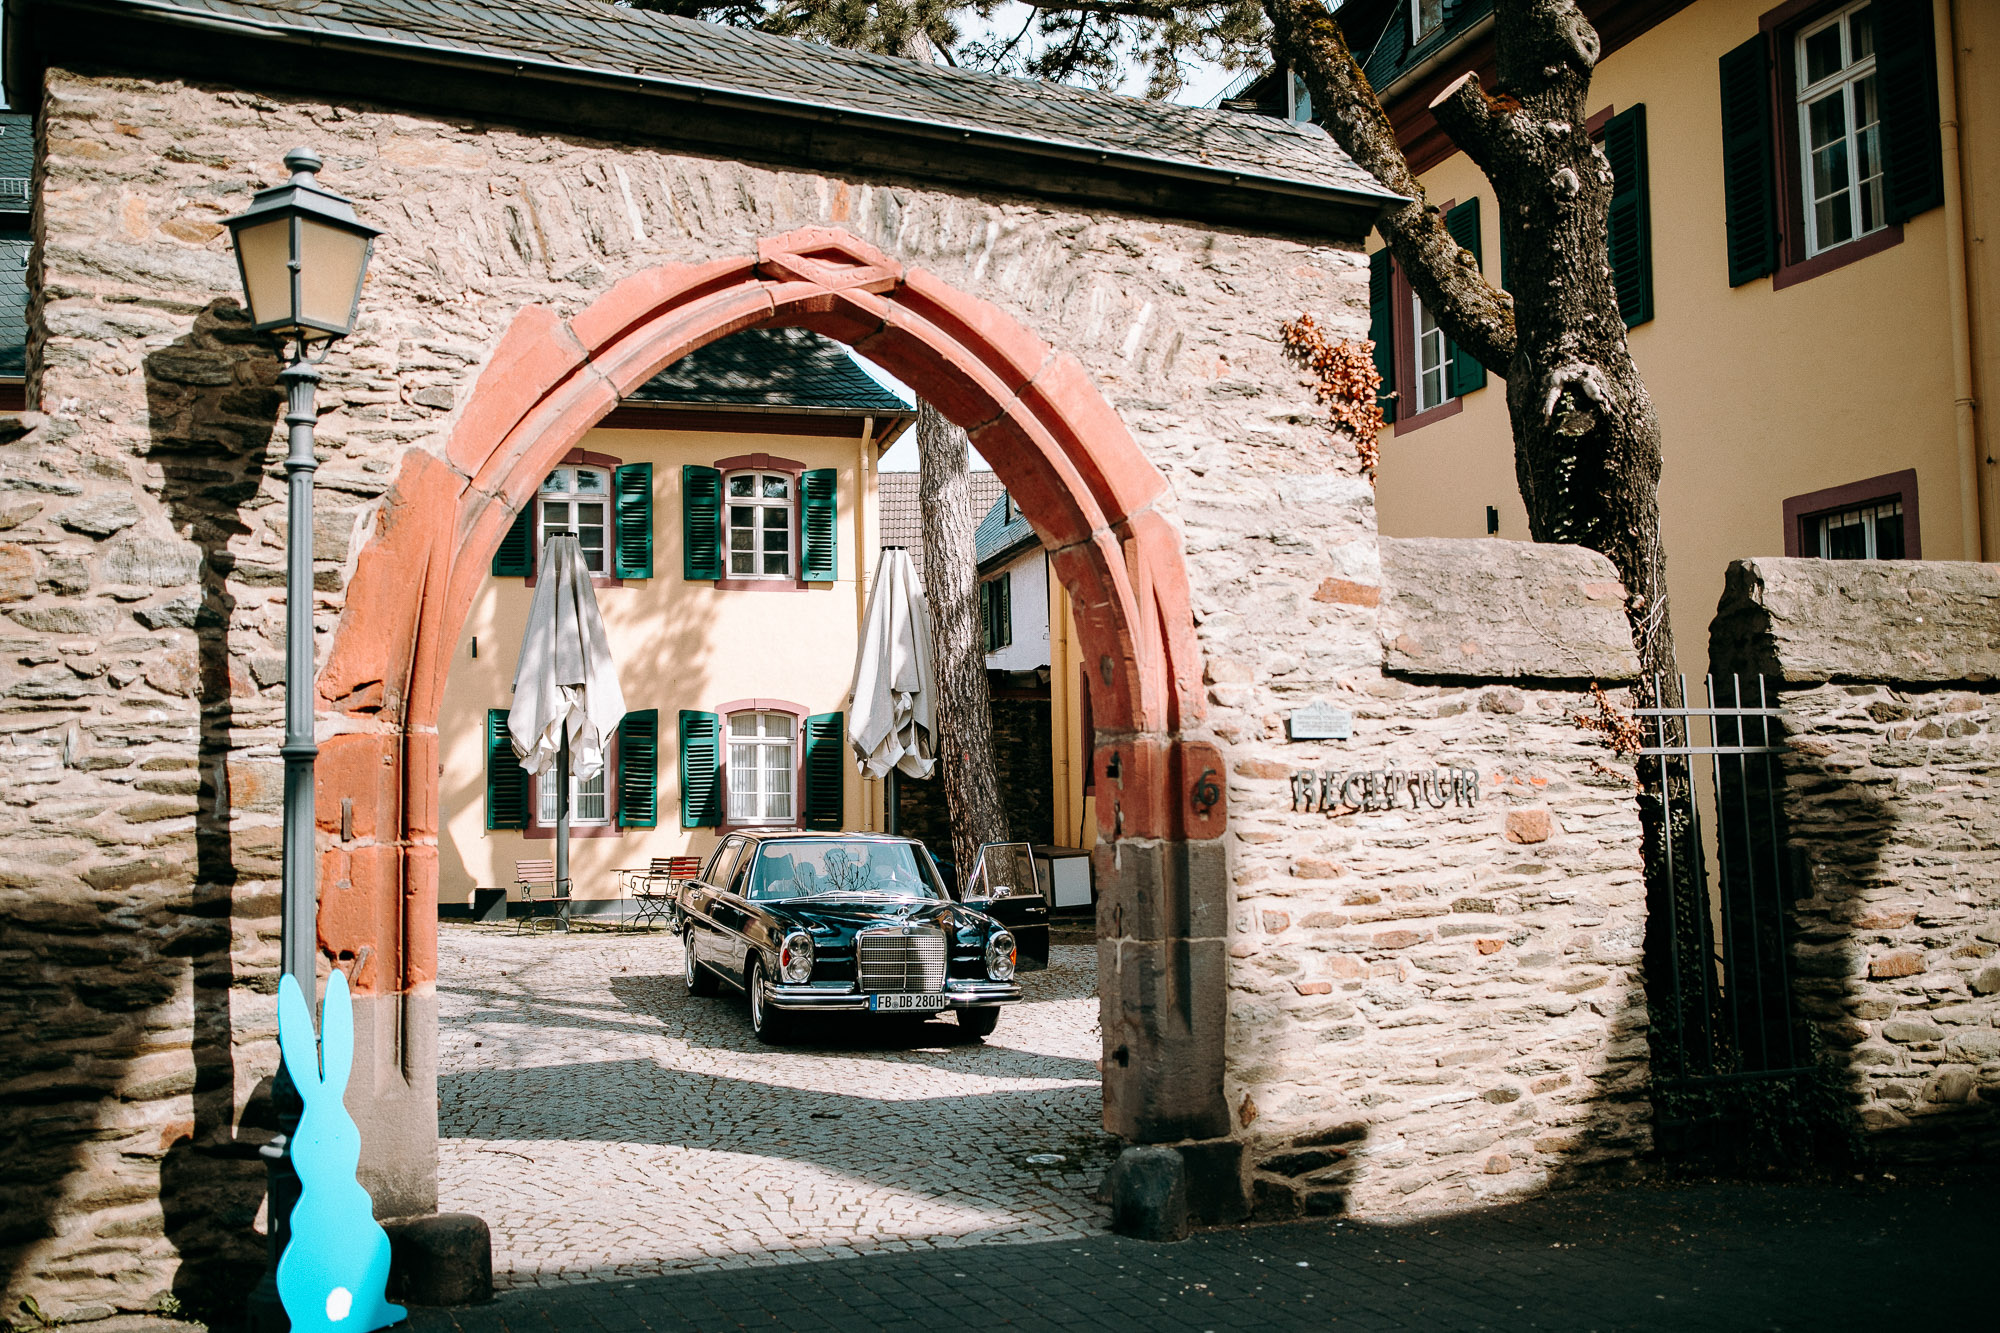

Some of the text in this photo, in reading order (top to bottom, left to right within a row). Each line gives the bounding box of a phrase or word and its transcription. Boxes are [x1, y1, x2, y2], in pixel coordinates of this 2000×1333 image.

[1198, 769, 1219, 806] 6
[1297, 768, 1480, 806] RECEPTUR
[878, 995, 943, 1008] FB DB 280H
